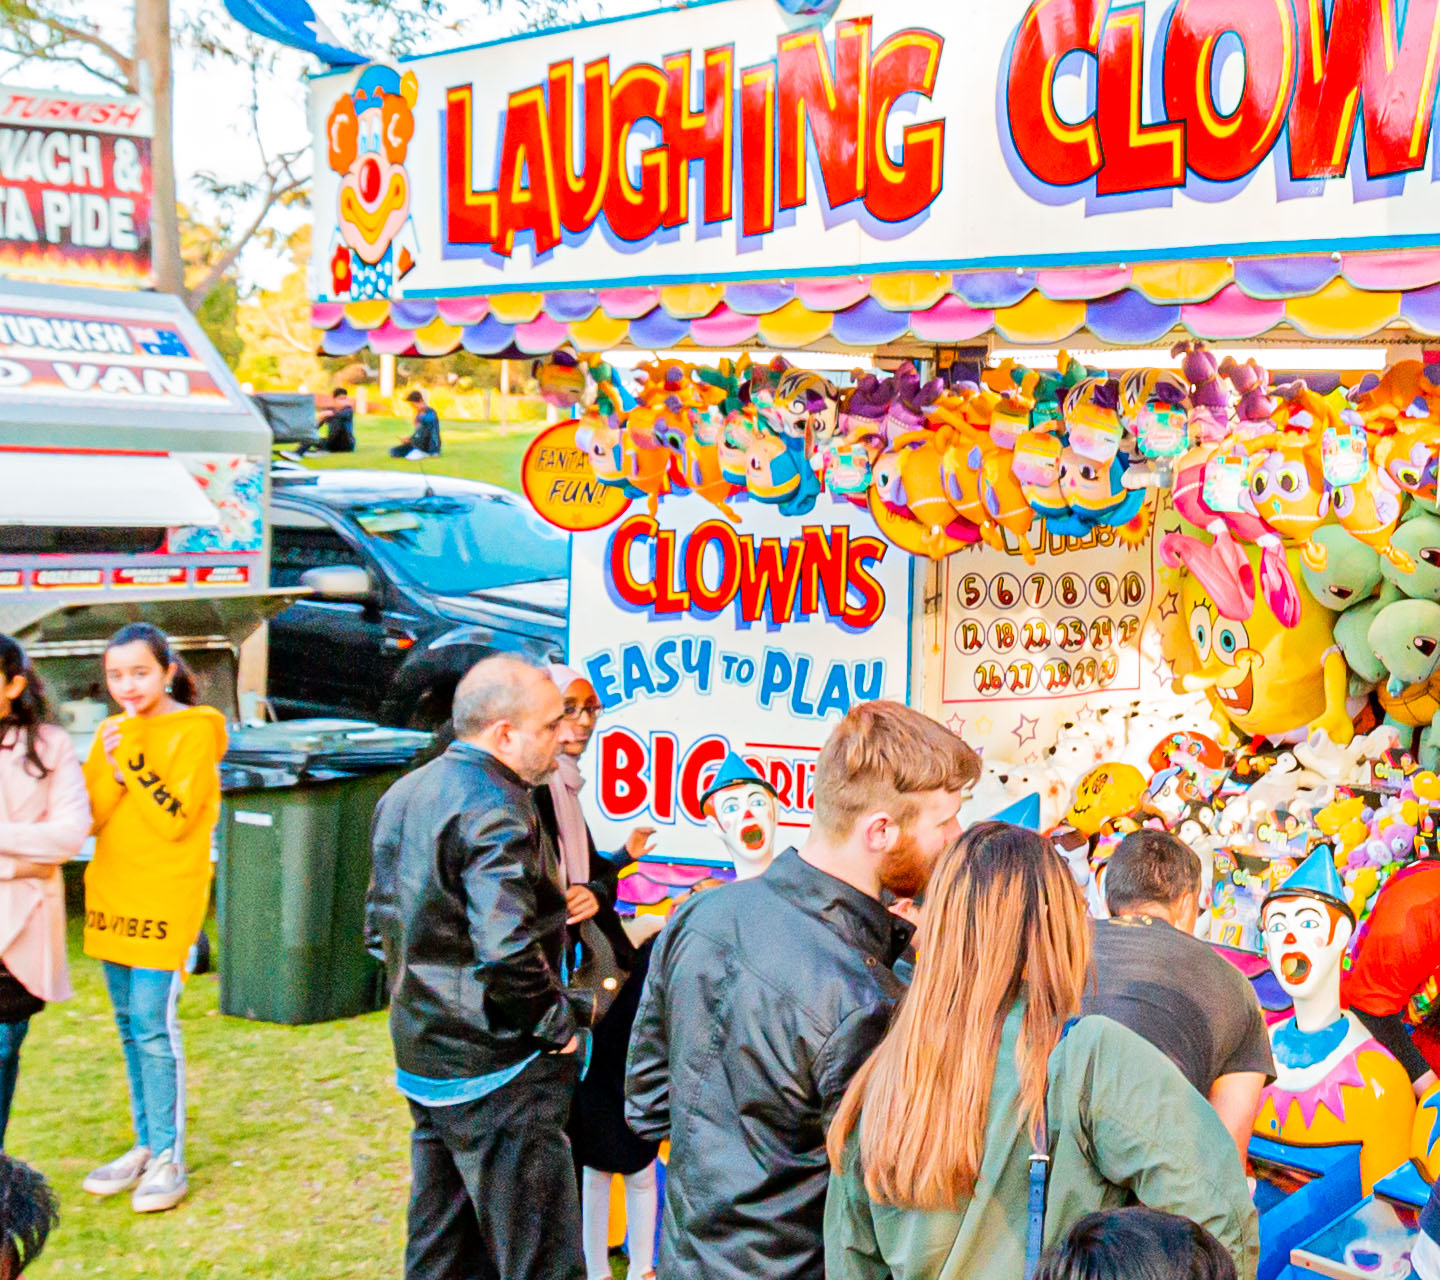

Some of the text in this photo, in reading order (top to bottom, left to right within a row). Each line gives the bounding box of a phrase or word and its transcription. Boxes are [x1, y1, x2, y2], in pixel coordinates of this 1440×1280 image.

[446, 15, 946, 258] LAUGHING
[113, 139, 144, 194] &
[42, 192, 139, 250] PIDE
[50, 361, 191, 398] VAN
[548, 479, 609, 506] FUN!
[610, 515, 888, 628] CLOWNS
[964, 575, 1142, 606] 5 6 7 8 9 10
[961, 622, 983, 650] 12
[995, 622, 1015, 649] 18
[1023, 621, 1052, 651] 22
[1057, 620, 1086, 648] 23
[1090, 619, 1114, 648] 24
[586, 638, 883, 717] EASY TO PLAY
[976, 664, 1003, 692] 26
[1009, 662, 1035, 692] 27
[1042, 663, 1071, 692] 28
